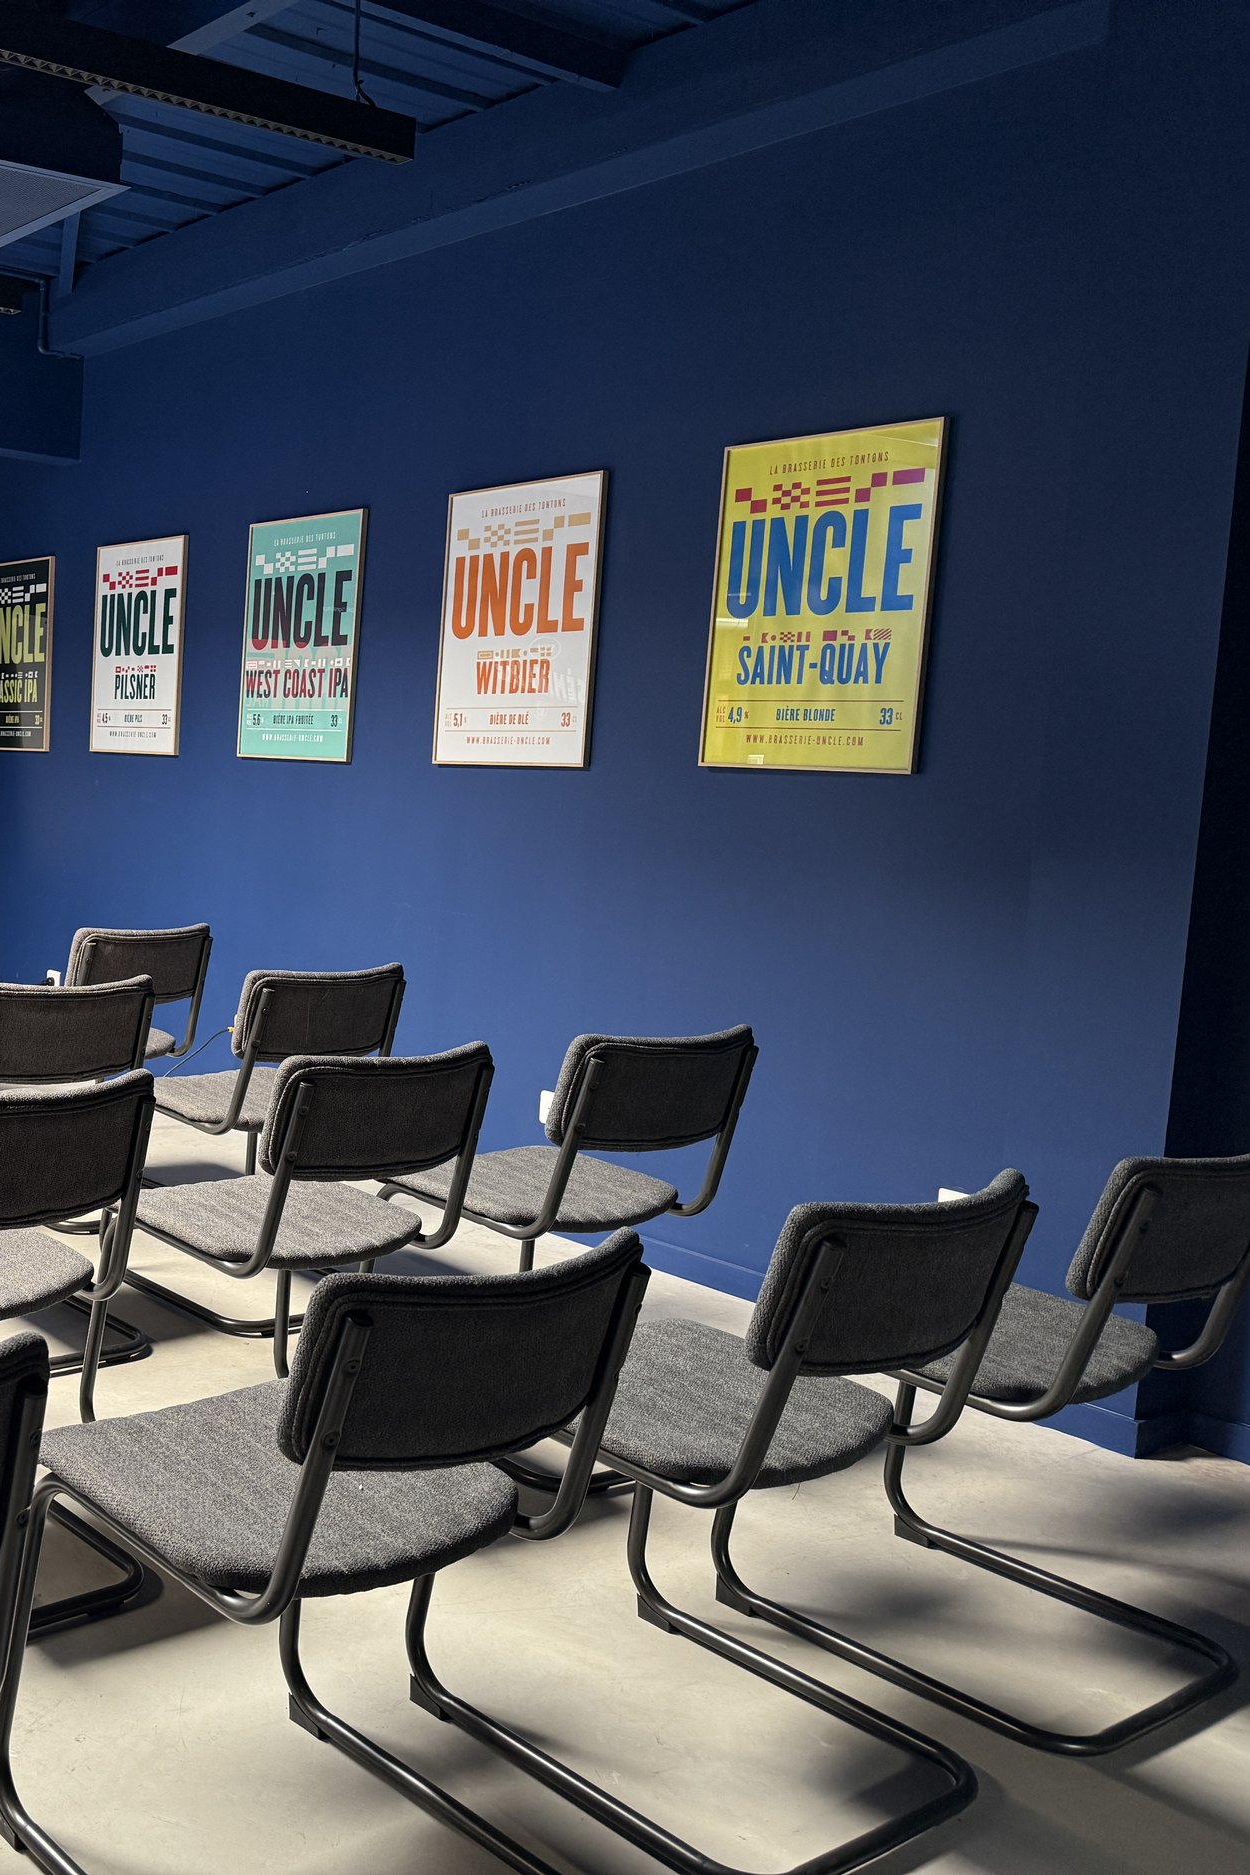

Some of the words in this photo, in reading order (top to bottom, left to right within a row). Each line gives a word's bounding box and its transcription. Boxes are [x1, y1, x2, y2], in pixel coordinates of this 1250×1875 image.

[769, 465, 779, 476] LA
[782, 461, 827, 474] BRASSERIE
[830, 456, 846, 469] DES
[850, 451, 890, 465] TONTONS
[726, 503, 923, 619] UNCLE
[451, 541, 590, 640] UNCLE
[99, 587, 177, 658] UNCLE
[251, 569, 353, 651] UNCLE
[736, 641, 892, 686] SAINT-QUAY
[114, 673, 157, 700] PILSNER
[245, 669, 281, 699] WEST
[283, 668, 326, 699] COAST
[327, 667, 349, 698] IPA
[476, 658, 551, 695] WITBIER
[24, 678, 38, 703] IPA
[161, 713, 168, 725] 33
[330, 714, 338, 727] 33
[453, 712, 463, 728] 5,1
[489, 712, 507, 725] BIÈRE
[508, 714, 517, 725] DE
[517, 711, 530, 725] BLÉ
[560, 712, 571, 727] 33
[727, 706, 743, 724] 4,9
[775, 705, 801, 721] BIÈRE
[803, 708, 837, 722] BLONDE
[879, 707, 894, 726] 33
[745, 734, 864, 746] WWW.BRASSERIE-UNCLE.COM
